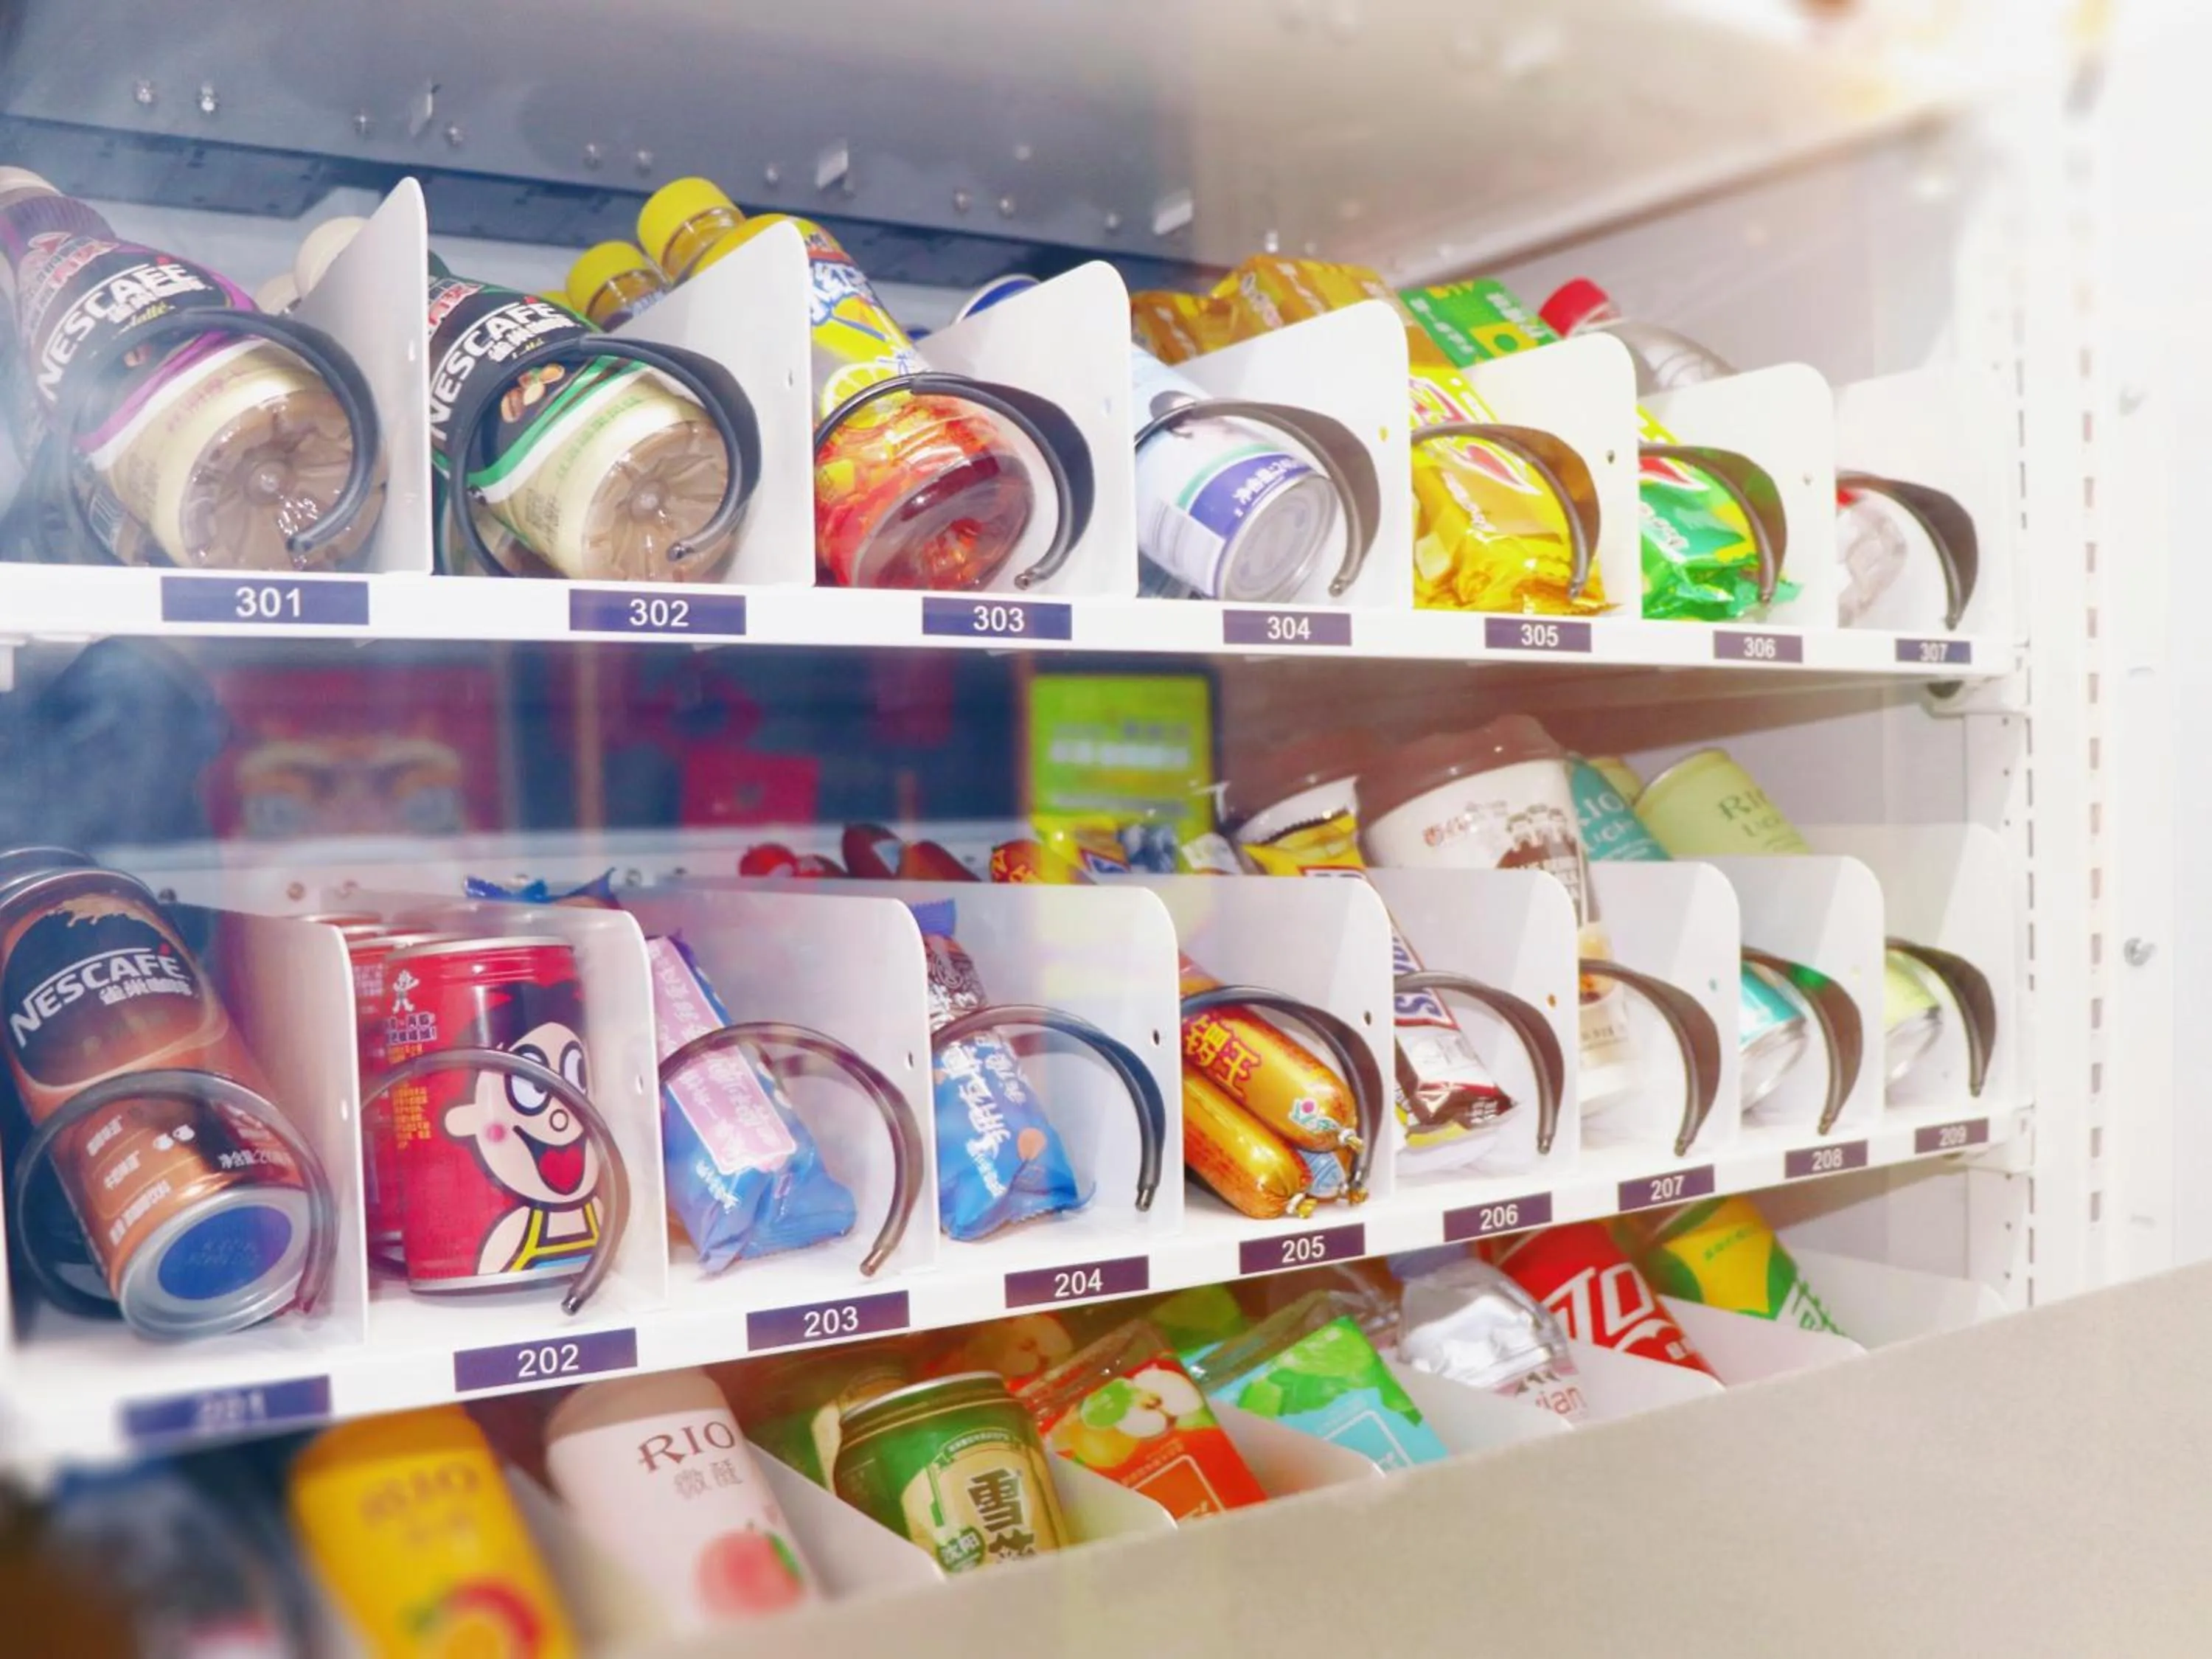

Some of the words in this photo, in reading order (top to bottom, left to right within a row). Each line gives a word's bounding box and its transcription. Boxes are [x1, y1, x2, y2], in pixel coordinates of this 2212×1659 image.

[235, 586, 300, 618] 301
[630, 599, 689, 627] 302
[973, 605, 1025, 633] 303
[1267, 616, 1311, 640] 304
[1520, 623, 1559, 648] 305
[1743, 636, 1775, 658] 306
[1919, 642, 1949, 662] 307
[1939, 1126, 1967, 1147] 209
[1812, 1149, 1843, 1171] 208
[1649, 1175, 1684, 1201] 207
[1479, 1203, 1519, 1231] 206
[1281, 1235, 1326, 1263] 205
[1053, 1267, 1104, 1298] 204
[803, 1306, 860, 1339] 203
[517, 1343, 580, 1378] 202
[638, 1420, 736, 1474] RIO
